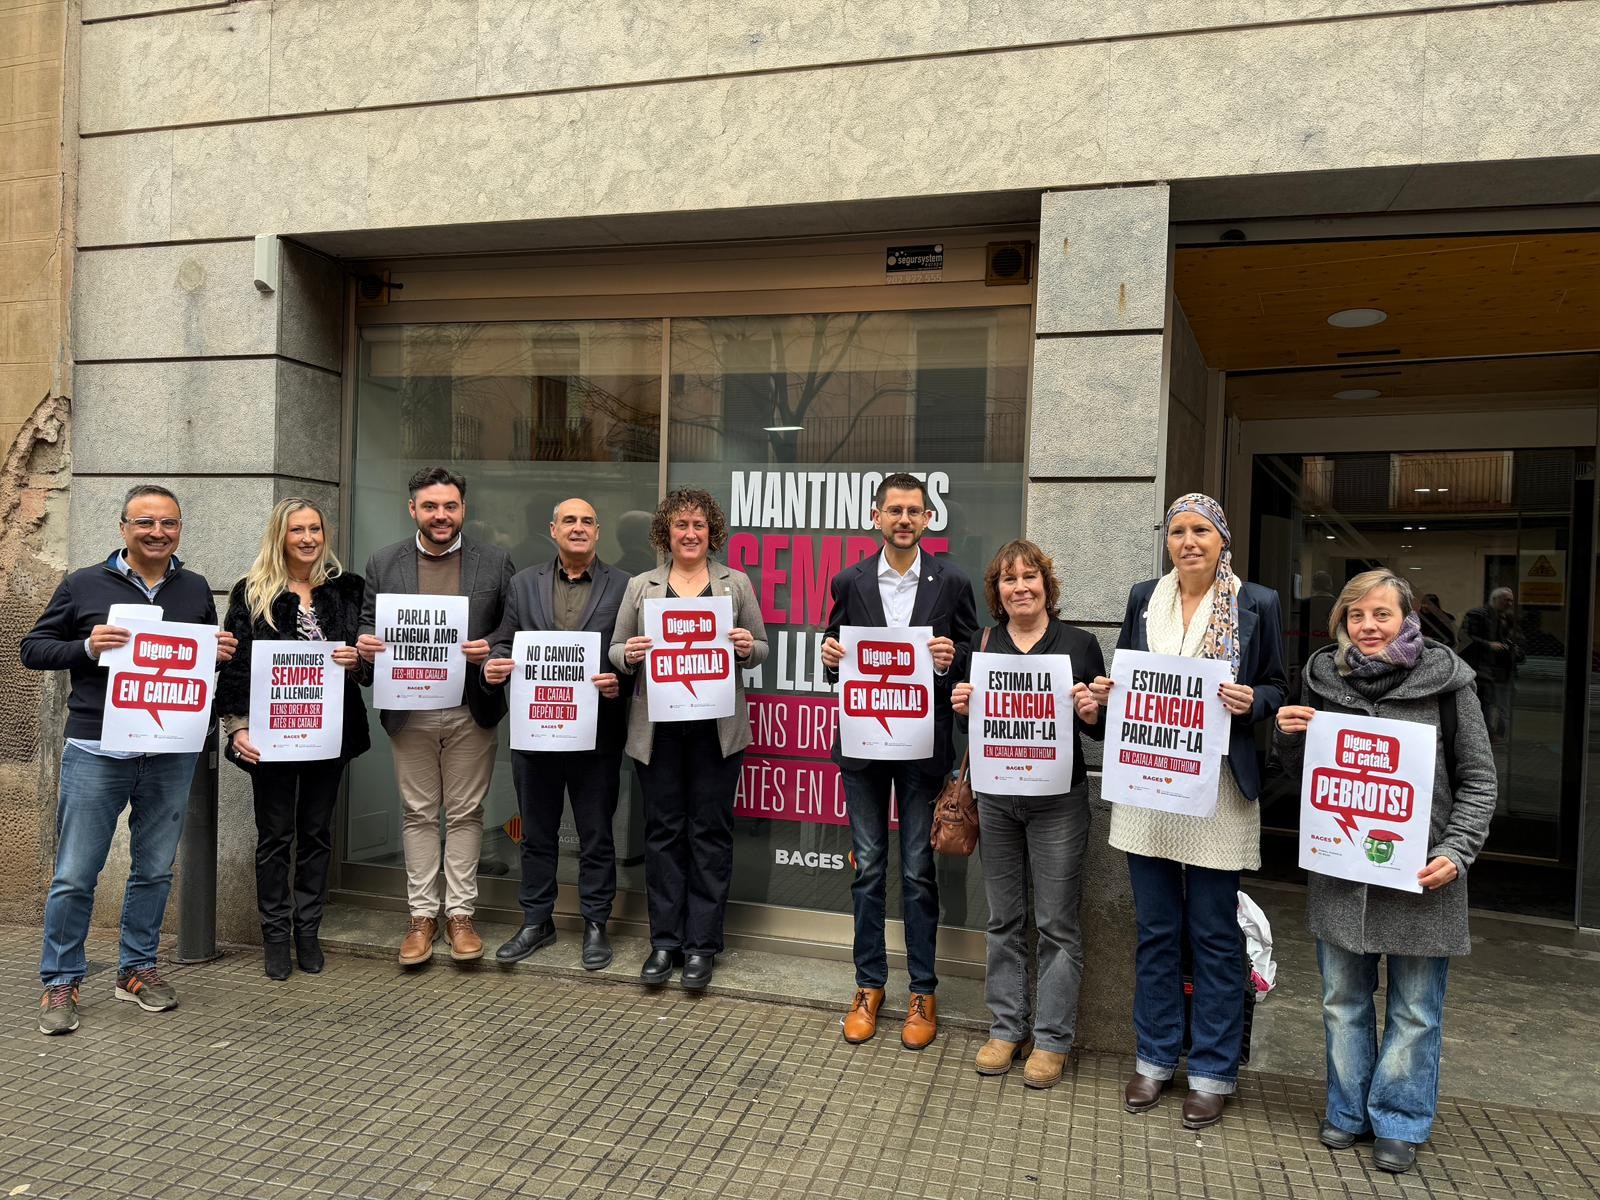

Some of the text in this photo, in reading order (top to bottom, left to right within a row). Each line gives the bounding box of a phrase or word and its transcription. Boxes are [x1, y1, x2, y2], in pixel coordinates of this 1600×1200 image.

[897, 254, 943, 267] segursystem
[730, 471, 950, 532] MANTINGS
[397, 608, 447, 625] PARLA LA
[667, 616, 712, 636] Digue-ho
[384, 627, 458, 644] LLENGUA AMB
[139, 641, 193, 661] Digue-ho
[272, 653, 325, 666] MANTINGUES
[393, 645, 449, 662] LLIBERTAT!
[526, 643, 585, 663] NO CANVIÏS
[862, 648, 911, 667] Digue-ho
[525, 664, 585, 682] DE LLENGUA
[656, 656, 673, 676] EN
[676, 650, 724, 675] CATALÀ!
[271, 666, 324, 686] SEMPRE
[393, 668, 415, 679] FES-HO
[415, 668, 424, 679] EN
[988, 670, 1052, 692] ESTIMA LA
[119, 679, 200, 706] EN CATALÀ!
[271, 686, 324, 700] LA LLENGUA!
[537, 687, 545, 701] EL
[1131, 669, 1203, 699] ESTIMA LA
[850, 686, 922, 711] EN CATALÀ!
[984, 691, 1056, 719] LLENGUA
[273, 703, 321, 715] TENS DRET A SER
[555, 706, 564, 719] DE
[566, 706, 575, 719] TU
[1124, 691, 1205, 730] LLENGUA
[288, 717, 297, 728] EN
[746, 702, 788, 748] ENS
[983, 719, 1056, 741] PARLANT-LA
[1121, 721, 1203, 754] PARLANT-LA
[1343, 733, 1390, 754] Digue-ho
[985, 745, 994, 757] EN
[1014, 747, 1028, 758] AMB
[1029, 747, 1054, 759] TOTHOM!
[1121, 750, 1130, 763] EN
[1153, 755, 1168, 769] AMB
[1169, 758, 1198, 774] TOTHOM!
[1342, 751, 1393, 771] en català,
[1142, 775, 1163, 783] BAGES
[795, 769, 824, 815] EN
[1315, 774, 1409, 817] PEBROTS!
[559, 836, 580, 844] AGES
[1310, 834, 1332, 843] BAGES
[775, 849, 844, 870] BAGES
